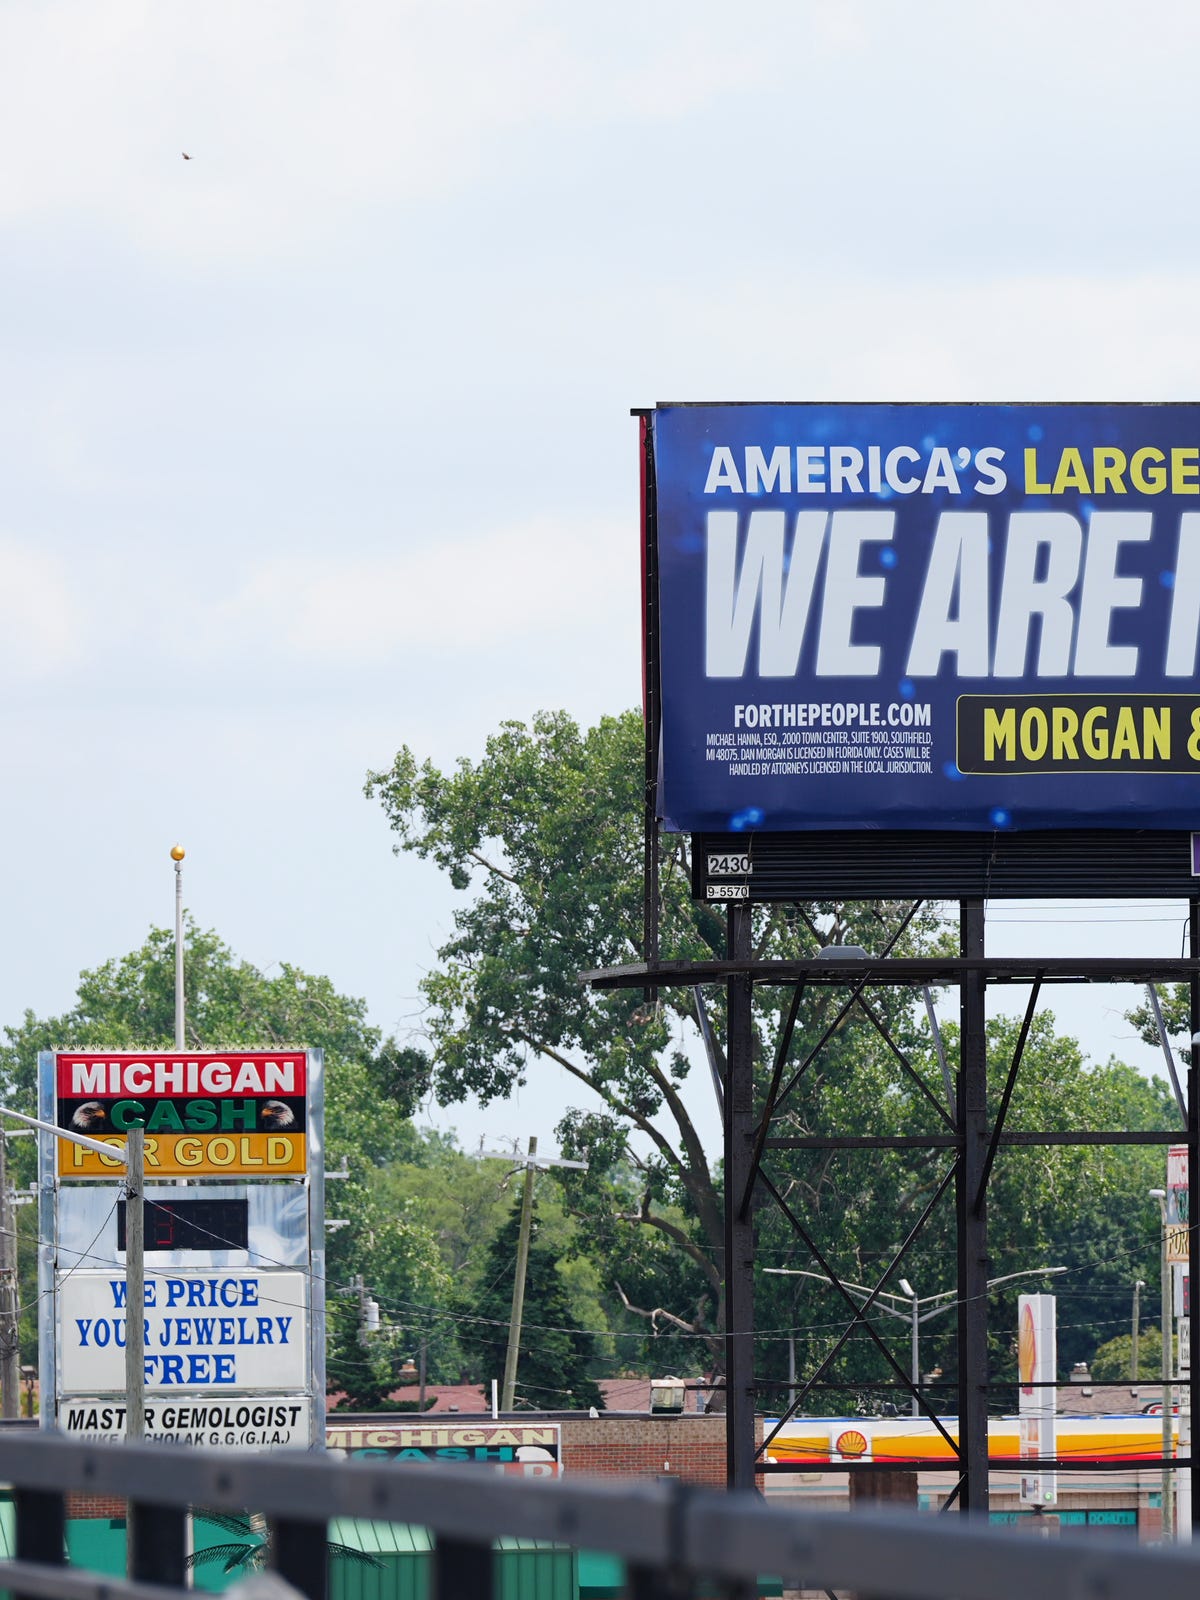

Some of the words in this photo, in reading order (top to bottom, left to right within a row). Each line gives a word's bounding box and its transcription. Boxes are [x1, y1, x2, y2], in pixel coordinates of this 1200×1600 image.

[703, 445, 1007, 495] AMERICA'S
[705, 510, 896, 678] WE
[905, 510, 1153, 678] ARE
[734, 703, 932, 728] FORTHEPEOPLE.COM
[706, 733, 737, 746] MICHAEL
[737, 733, 763, 747] HANNA,
[782, 732, 801, 745] 2000
[801, 731, 822, 744] TOWN
[822, 731, 850, 746] CENTER,
[851, 731, 870, 744] SUITE
[870, 731, 890, 746] 1900,
[890, 731, 933, 746] SOUTHFIELD,
[983, 706, 1171, 762] MORGAN
[706, 748, 715, 761] MI
[715, 748, 740, 761] 48075.
[740, 748, 755, 760] DAN
[756, 747, 786, 760] MORGAN
[786, 747, 793, 760] IS
[794, 746, 826, 759] LICENSED
[826, 746, 834, 759] IN
[835, 746, 863, 759] FLORIDA
[863, 746, 882, 759] ONLY.
[883, 746, 904, 759] CASES
[904, 746, 921, 759] WILL
[921, 746, 931, 759] BE
[729, 763, 760, 776] HANDLED
[761, 762, 771, 775] BY
[771, 761, 809, 775] ATTORNEYS
[809, 761, 841, 774] LICENSED
[842, 761, 850, 774] IN
[850, 761, 863, 774] THE
[864, 761, 885, 774] LOCAL
[885, 761, 933, 774] JURISDICTION.
[710, 857, 750, 873] 2430
[707, 887, 748, 897] 9-5570
[72, 1061, 295, 1094] MICHIGAN
[110, 1099, 257, 1131] CASH
[73, 1137, 160, 1168] FOR
[173, 1137, 294, 1166] GOLD
[165, 1279, 259, 1308] PRICE
[159, 1316, 293, 1347] JEWELRY
[142, 1354, 236, 1385] FREE
[67, 1407, 155, 1430] MASTR
[161, 1406, 302, 1429] GEMOLOGIST
[325, 1429, 554, 1448] MICHIGAN
[351, 1446, 513, 1463] CASH
